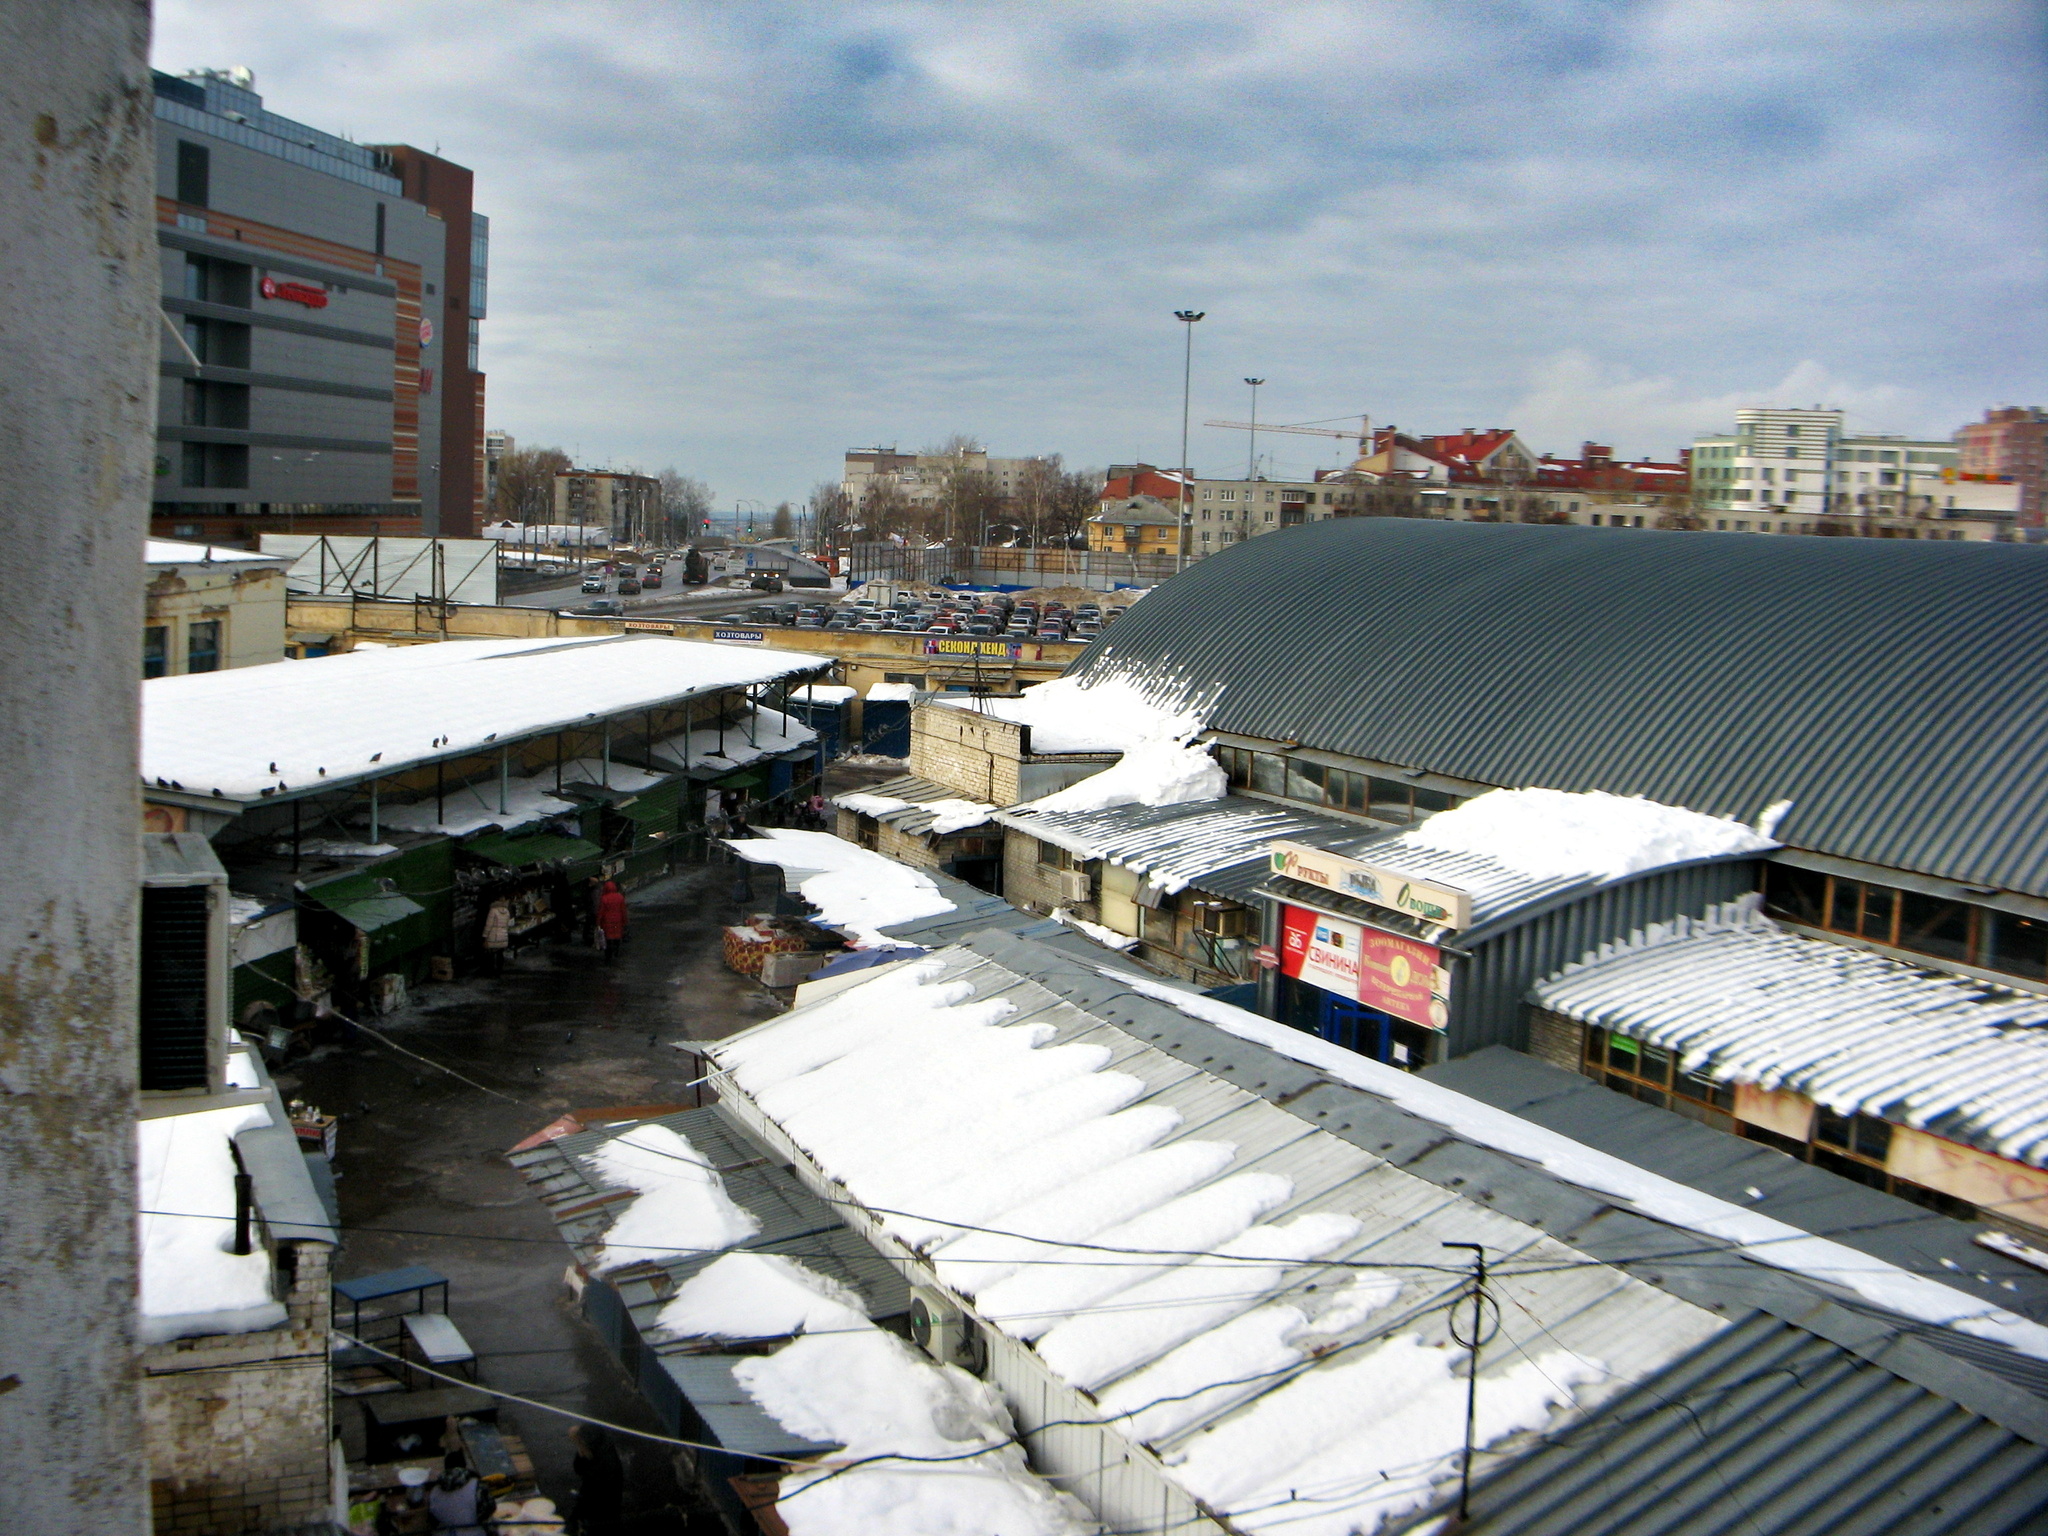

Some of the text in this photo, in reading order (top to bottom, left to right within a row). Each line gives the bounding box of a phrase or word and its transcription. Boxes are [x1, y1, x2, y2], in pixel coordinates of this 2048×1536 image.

[628, 622, 671, 630] ХОЗТОВАРЫ
[715, 630, 762, 640] ХОЗТОВАРЫ
[938, 640, 1007, 657] СЕКОНД ХЕНД
[1309, 945, 1359, 975] СВИНИНА
